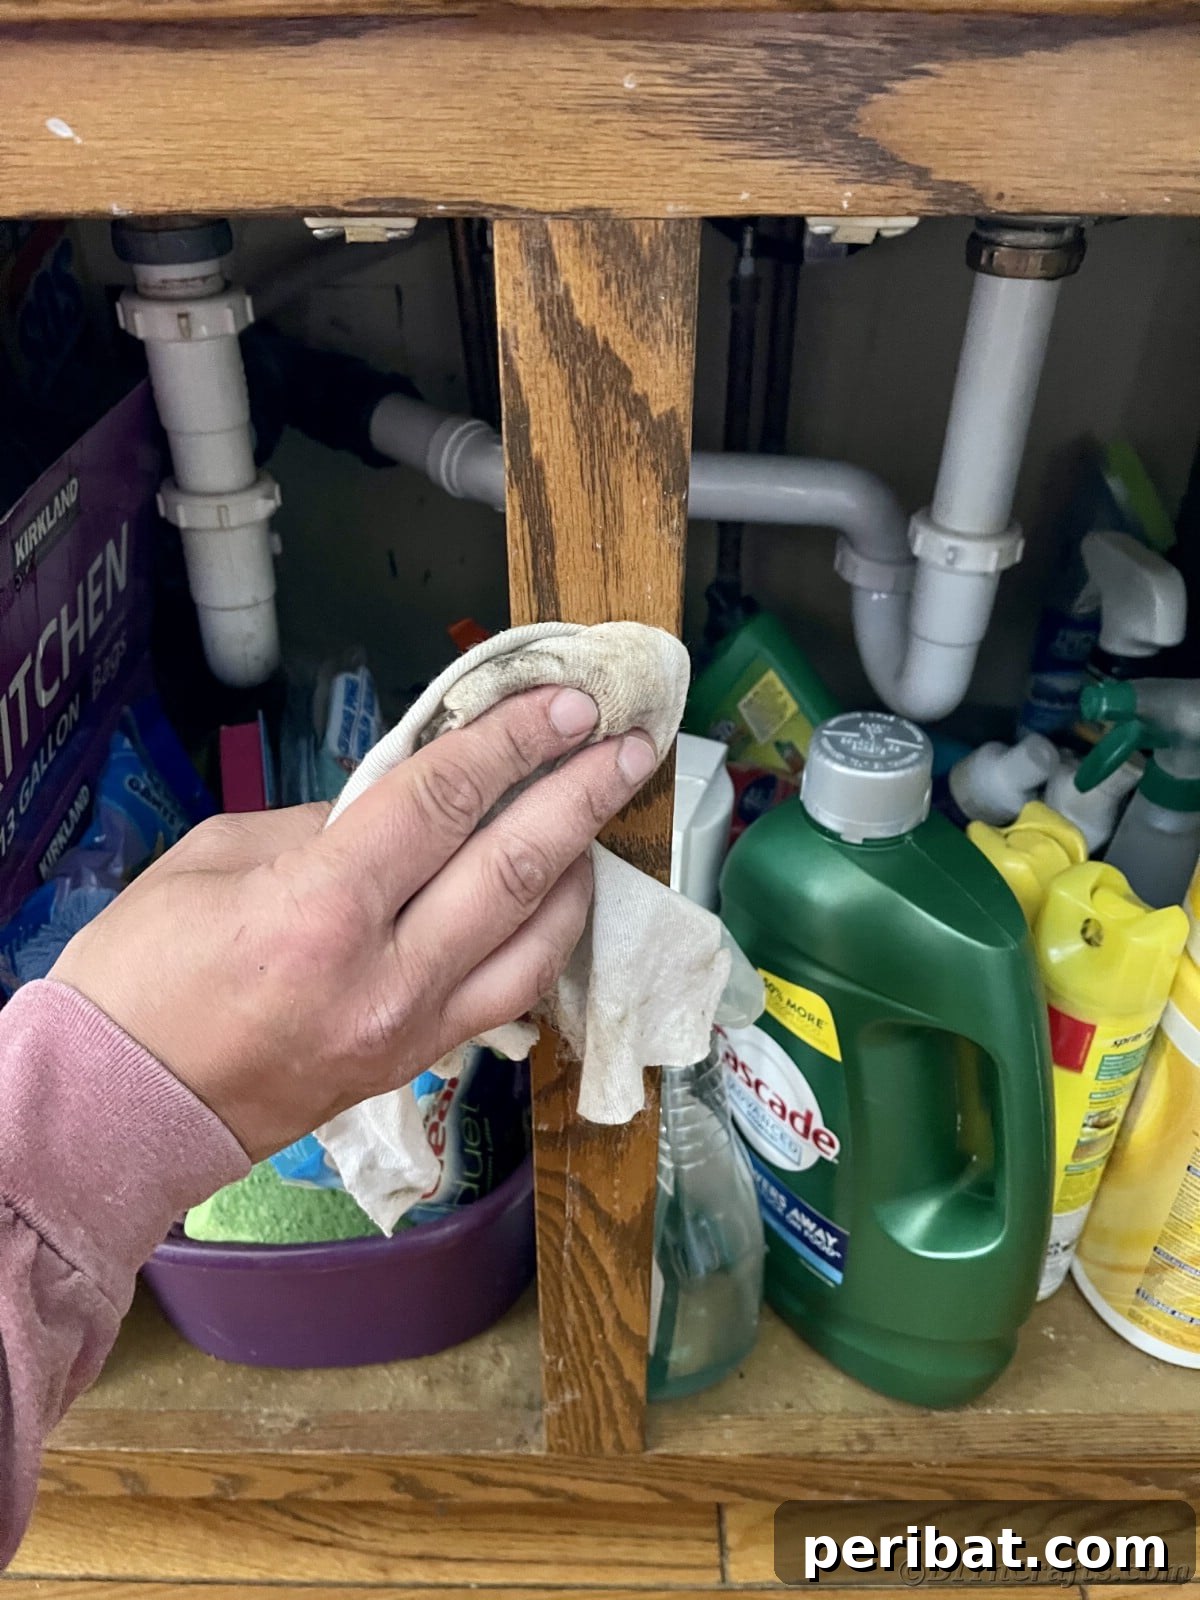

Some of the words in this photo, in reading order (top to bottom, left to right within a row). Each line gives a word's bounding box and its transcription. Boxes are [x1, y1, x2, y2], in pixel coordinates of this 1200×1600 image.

[14, 477, 80, 567] KIRKLAND
[0, 521, 129, 792] ITCHEN
[18, 693, 81, 815] GALLON
[38, 783, 90, 880] KIRKLAND
[786, 996, 825, 1030] MORE
[790, 1203, 838, 1248] AWAY
